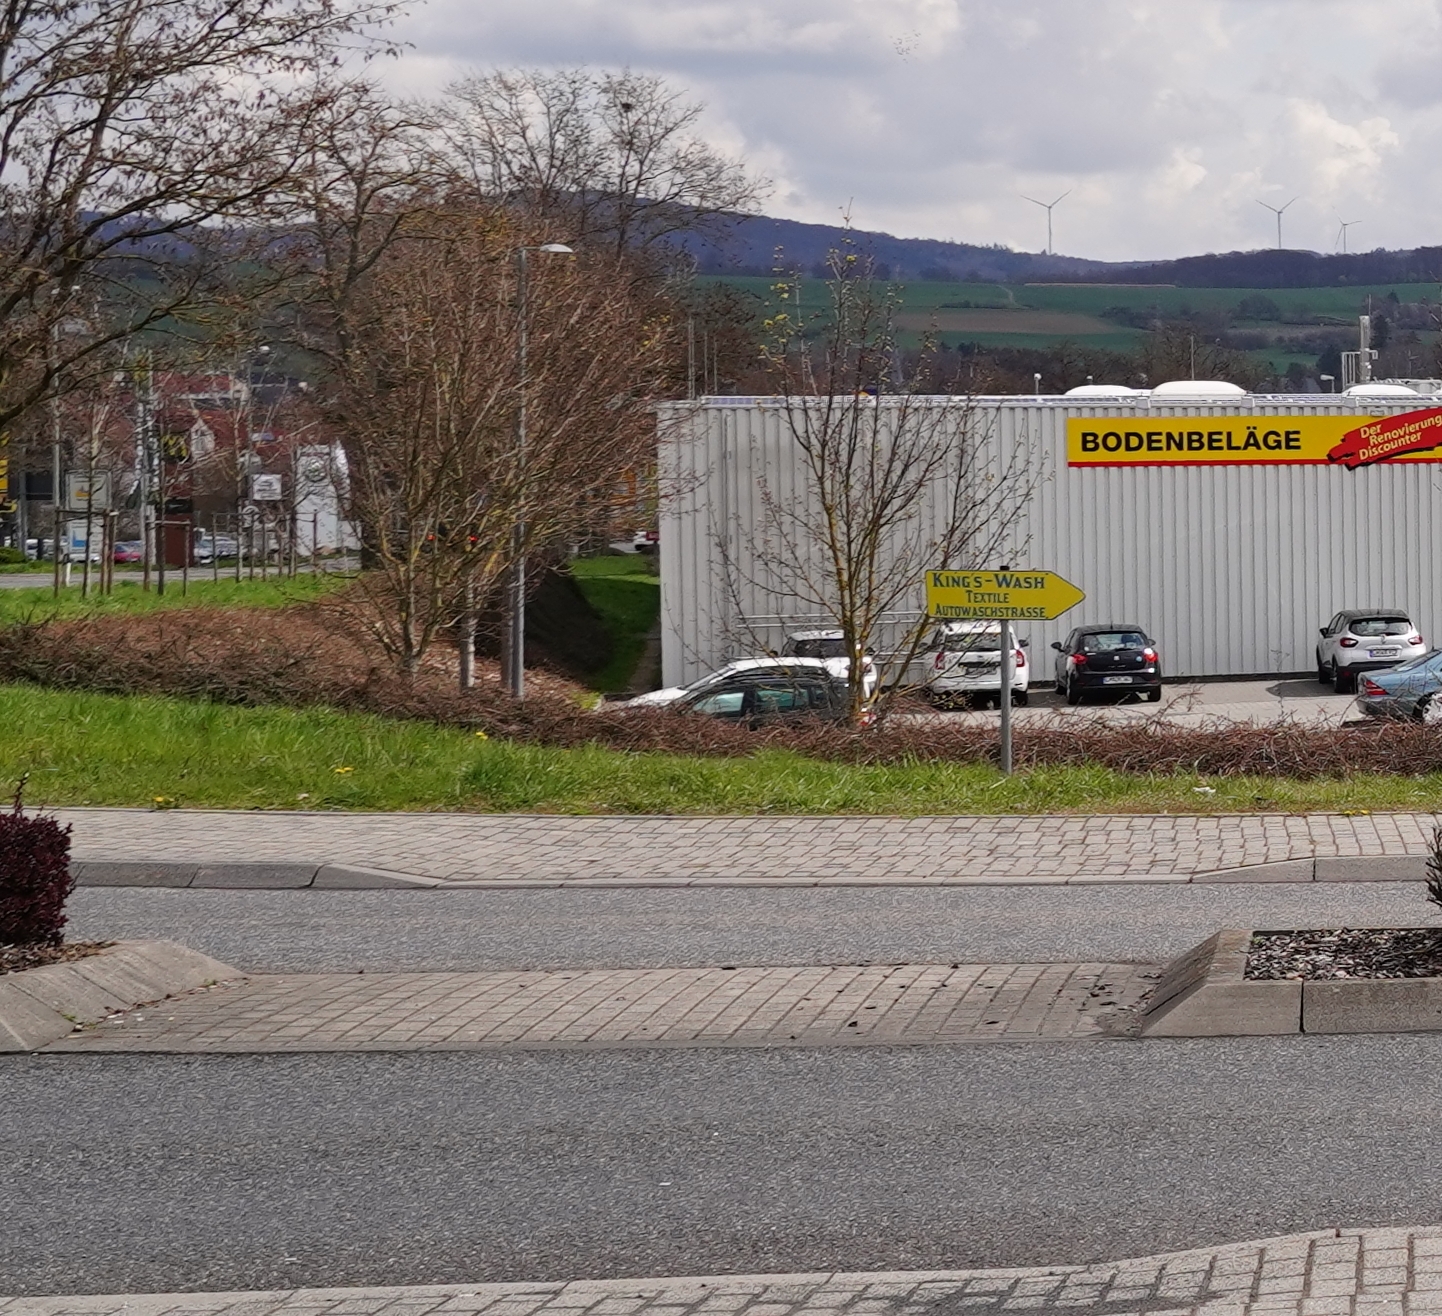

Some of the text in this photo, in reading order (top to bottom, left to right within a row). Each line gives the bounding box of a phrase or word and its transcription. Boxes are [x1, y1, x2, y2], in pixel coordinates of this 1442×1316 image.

[1080, 426, 1302, 452] BODENBELÄGE
[1360, 424, 1382, 439] Der
[1359, 431, 1422, 460] Discounter
[966, 590, 1010, 604] TEXTILE
[935, 603, 1046, 618] AUTOWASCHSTRASSE
